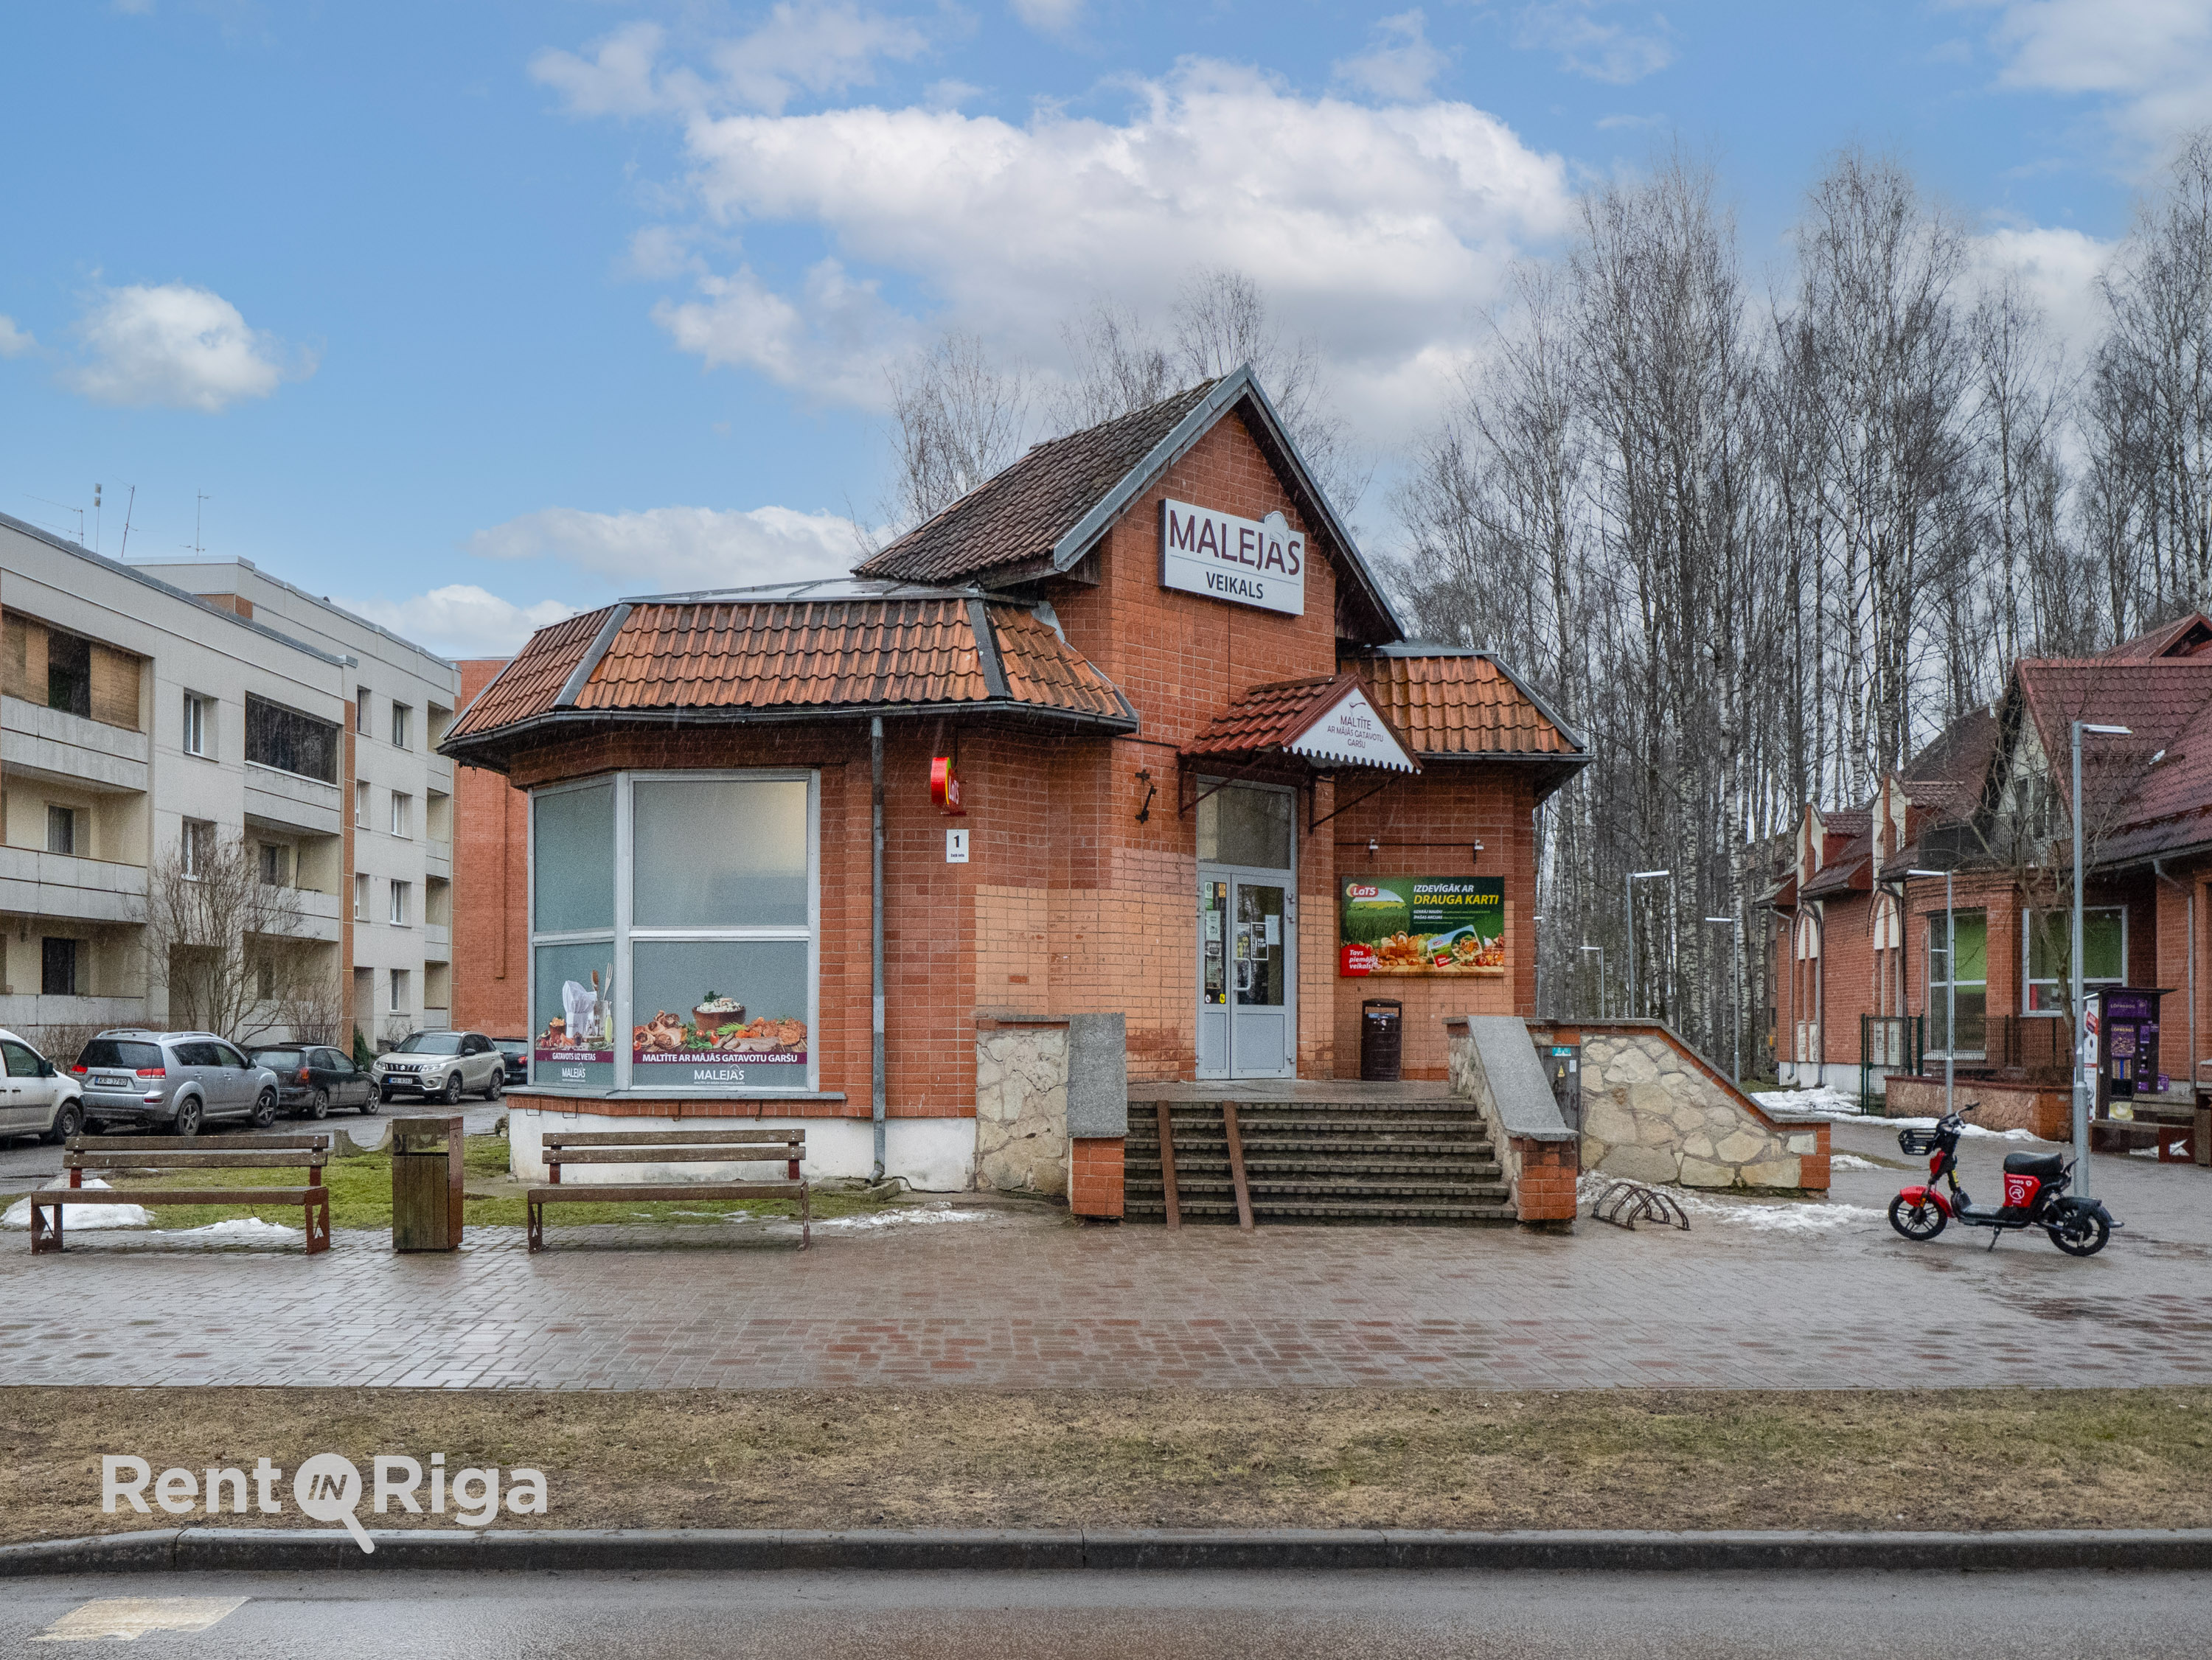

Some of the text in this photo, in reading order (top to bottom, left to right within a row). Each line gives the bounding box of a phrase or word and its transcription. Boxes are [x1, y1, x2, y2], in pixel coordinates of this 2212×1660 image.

[1169, 509, 1301, 576] MALEJAS
[1206, 571, 1264, 599] VEIKALS
[1340, 715, 1371, 730] MALTĪTE
[1327, 725, 1384, 742] AR MĀJĀS GATAVOTU
[1347, 738, 1366, 748] GARŠU
[953, 834, 959, 848] 1
[1352, 887, 1376, 896] LaTS
[1413, 883, 1474, 893] IZDEVĪGĀK AR
[1413, 894, 1499, 904] DRAUGA KARTI
[552, 1052, 596, 1061] GATAVOTS UZ VIETAS
[642, 1052, 797, 1063] MALTĪTE AR MĀJĀS GATAVOTU GARŠU
[694, 1069, 745, 1081] MALEJAS
